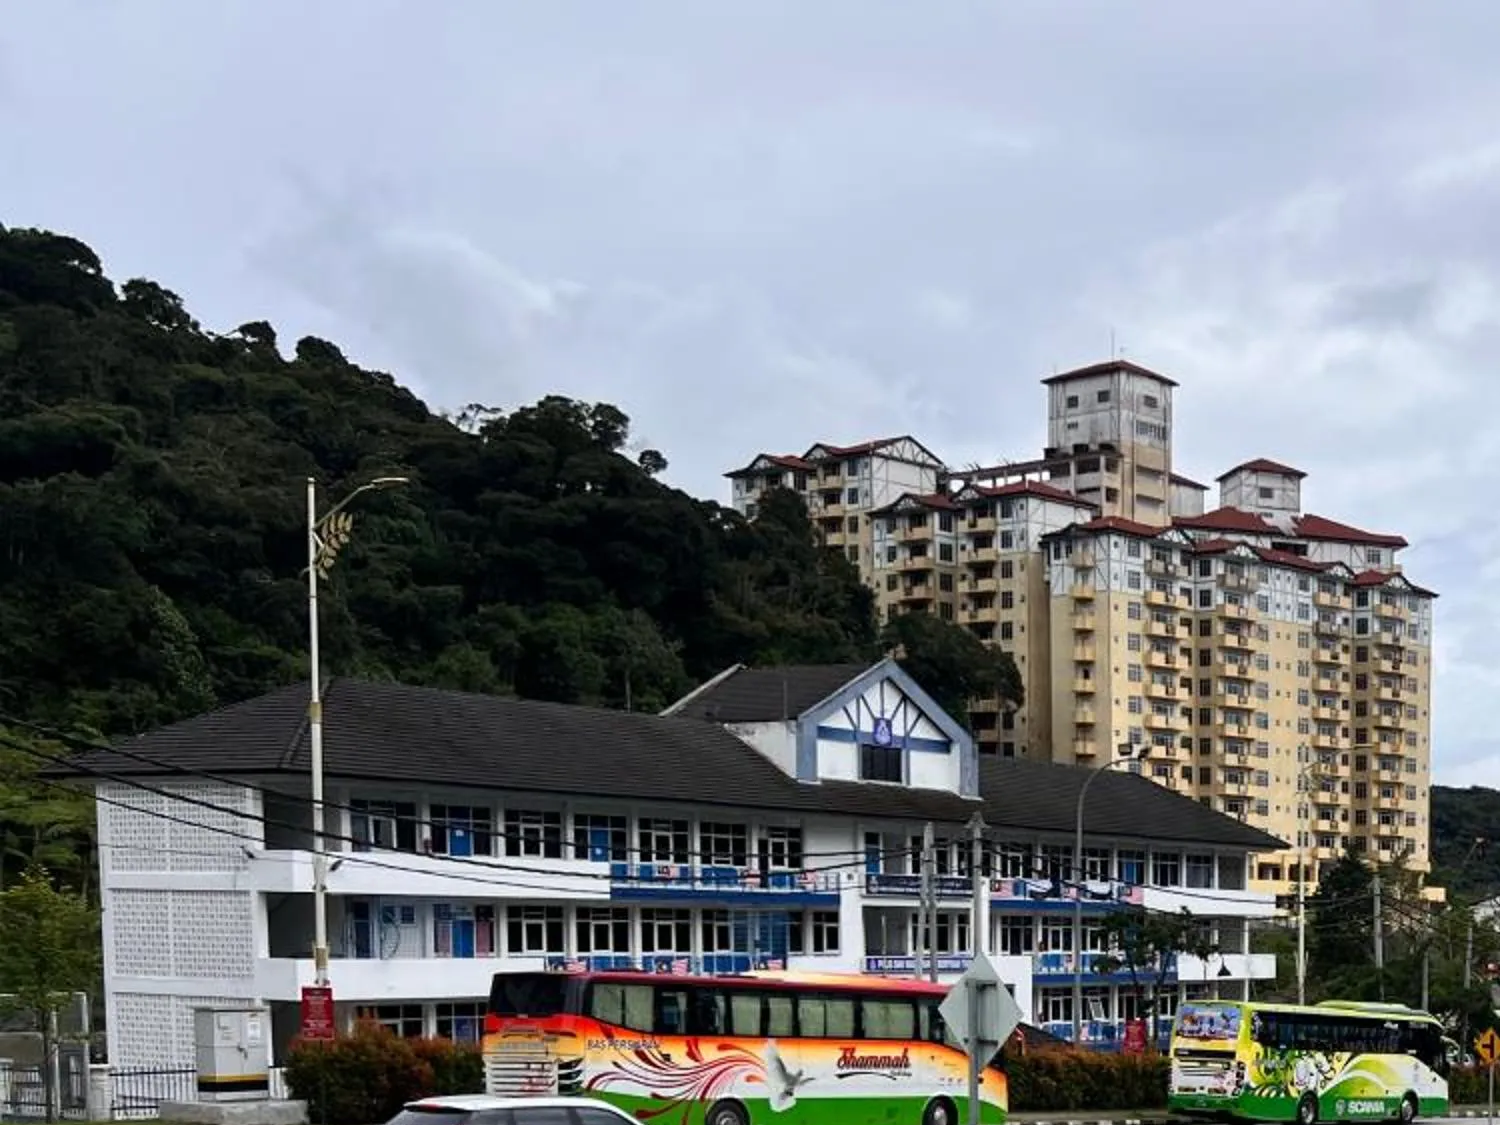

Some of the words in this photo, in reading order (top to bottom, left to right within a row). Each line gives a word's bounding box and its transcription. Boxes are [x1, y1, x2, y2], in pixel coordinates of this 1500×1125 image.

[587, 1039, 607, 1050] BAS
[837, 1047, 911, 1069] Shammah
[1348, 1100, 1384, 1113] SCANIA
